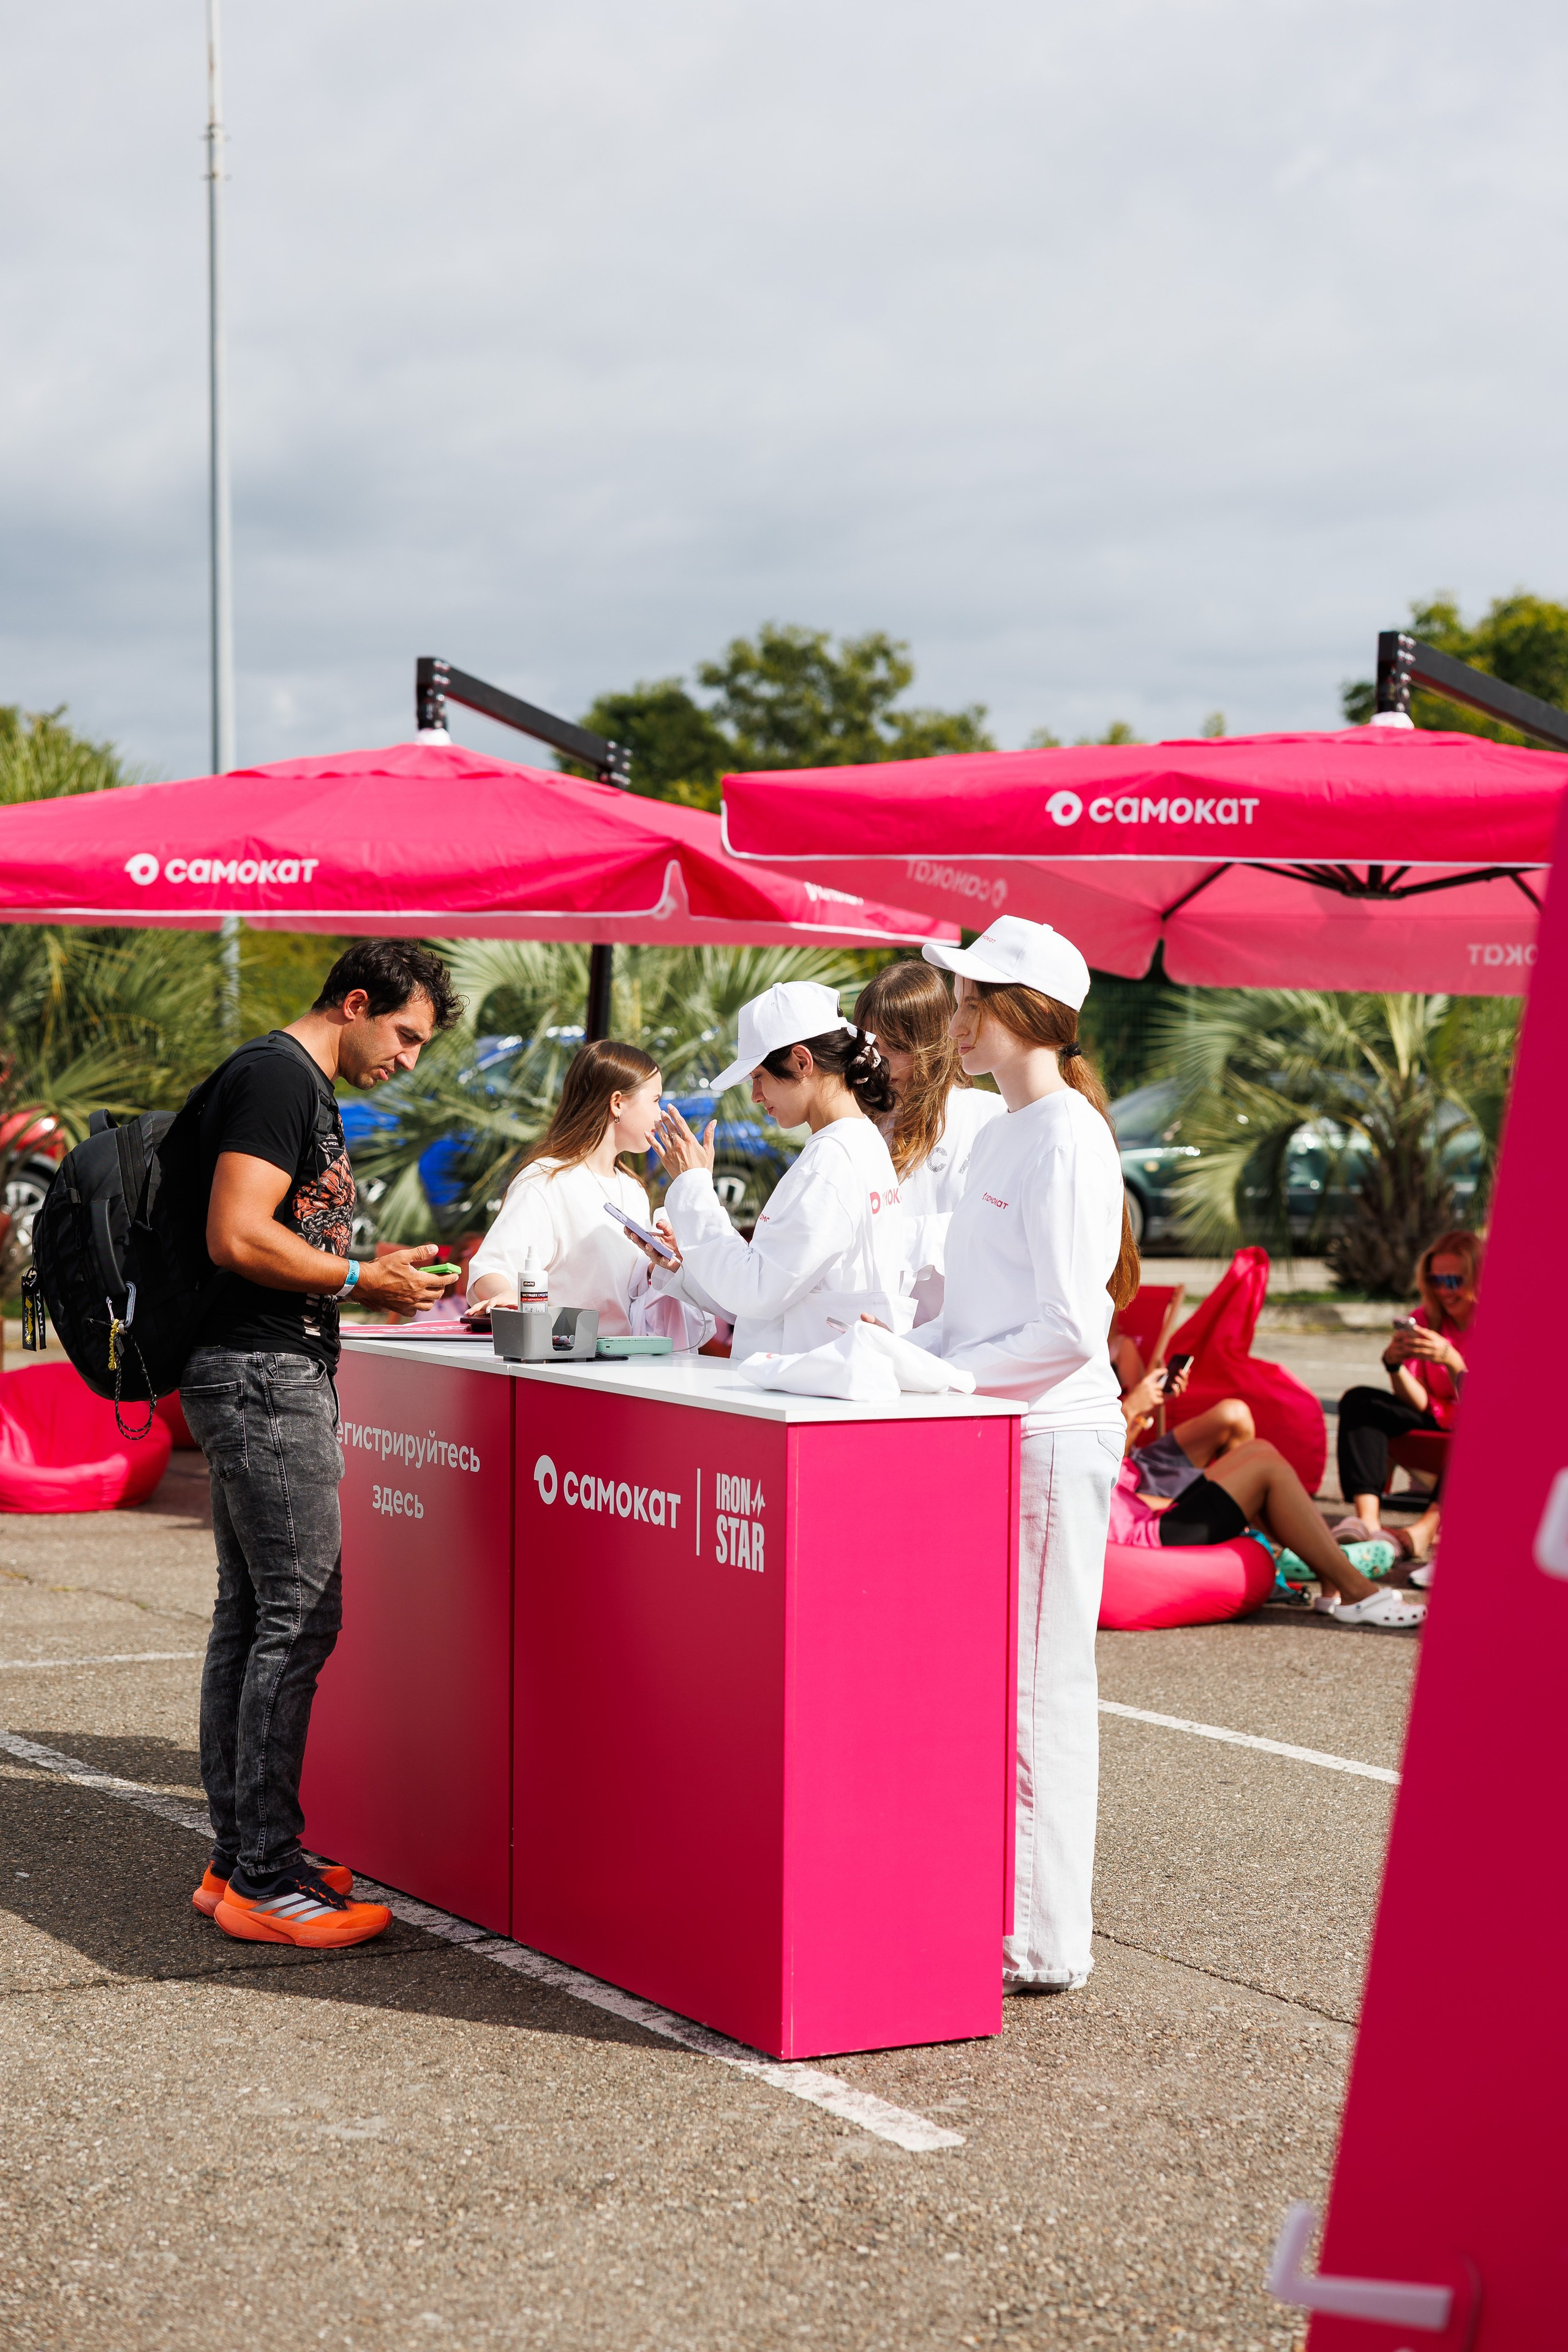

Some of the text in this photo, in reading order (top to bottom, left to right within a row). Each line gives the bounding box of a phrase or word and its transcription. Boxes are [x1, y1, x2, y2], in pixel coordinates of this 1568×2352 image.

[1088, 796, 1260, 825] самокат
[164, 858, 319, 884] самокат
[335, 1420, 480, 1472] егистрируйтесь
[372, 1484, 424, 1519] здесь
[563, 1471, 681, 1529] самокат
[716, 1472, 751, 1516] IRON
[715, 1515, 765, 1573] STAR
